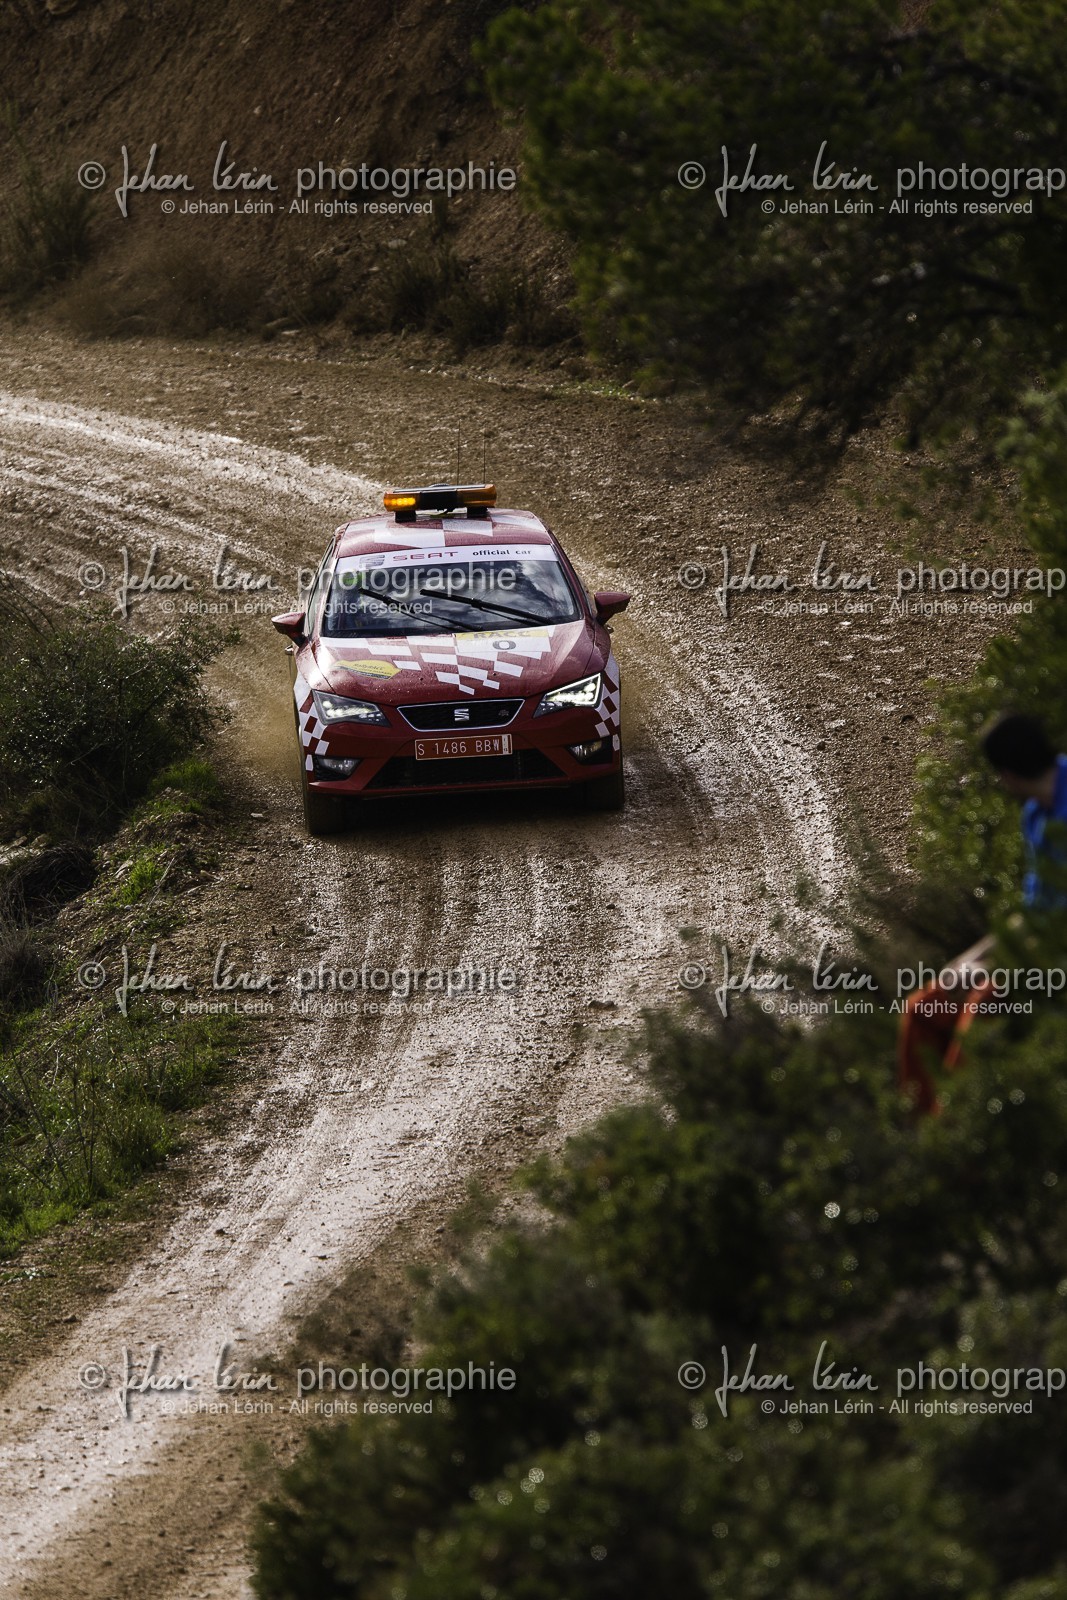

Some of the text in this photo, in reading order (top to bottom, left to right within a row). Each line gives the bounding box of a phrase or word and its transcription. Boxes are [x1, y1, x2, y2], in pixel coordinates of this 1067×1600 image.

[392, 551, 458, 561] SEAT
[417, 743, 425, 756] S
[434, 741, 467, 755] 1486
[475, 739, 500, 753] BBW
